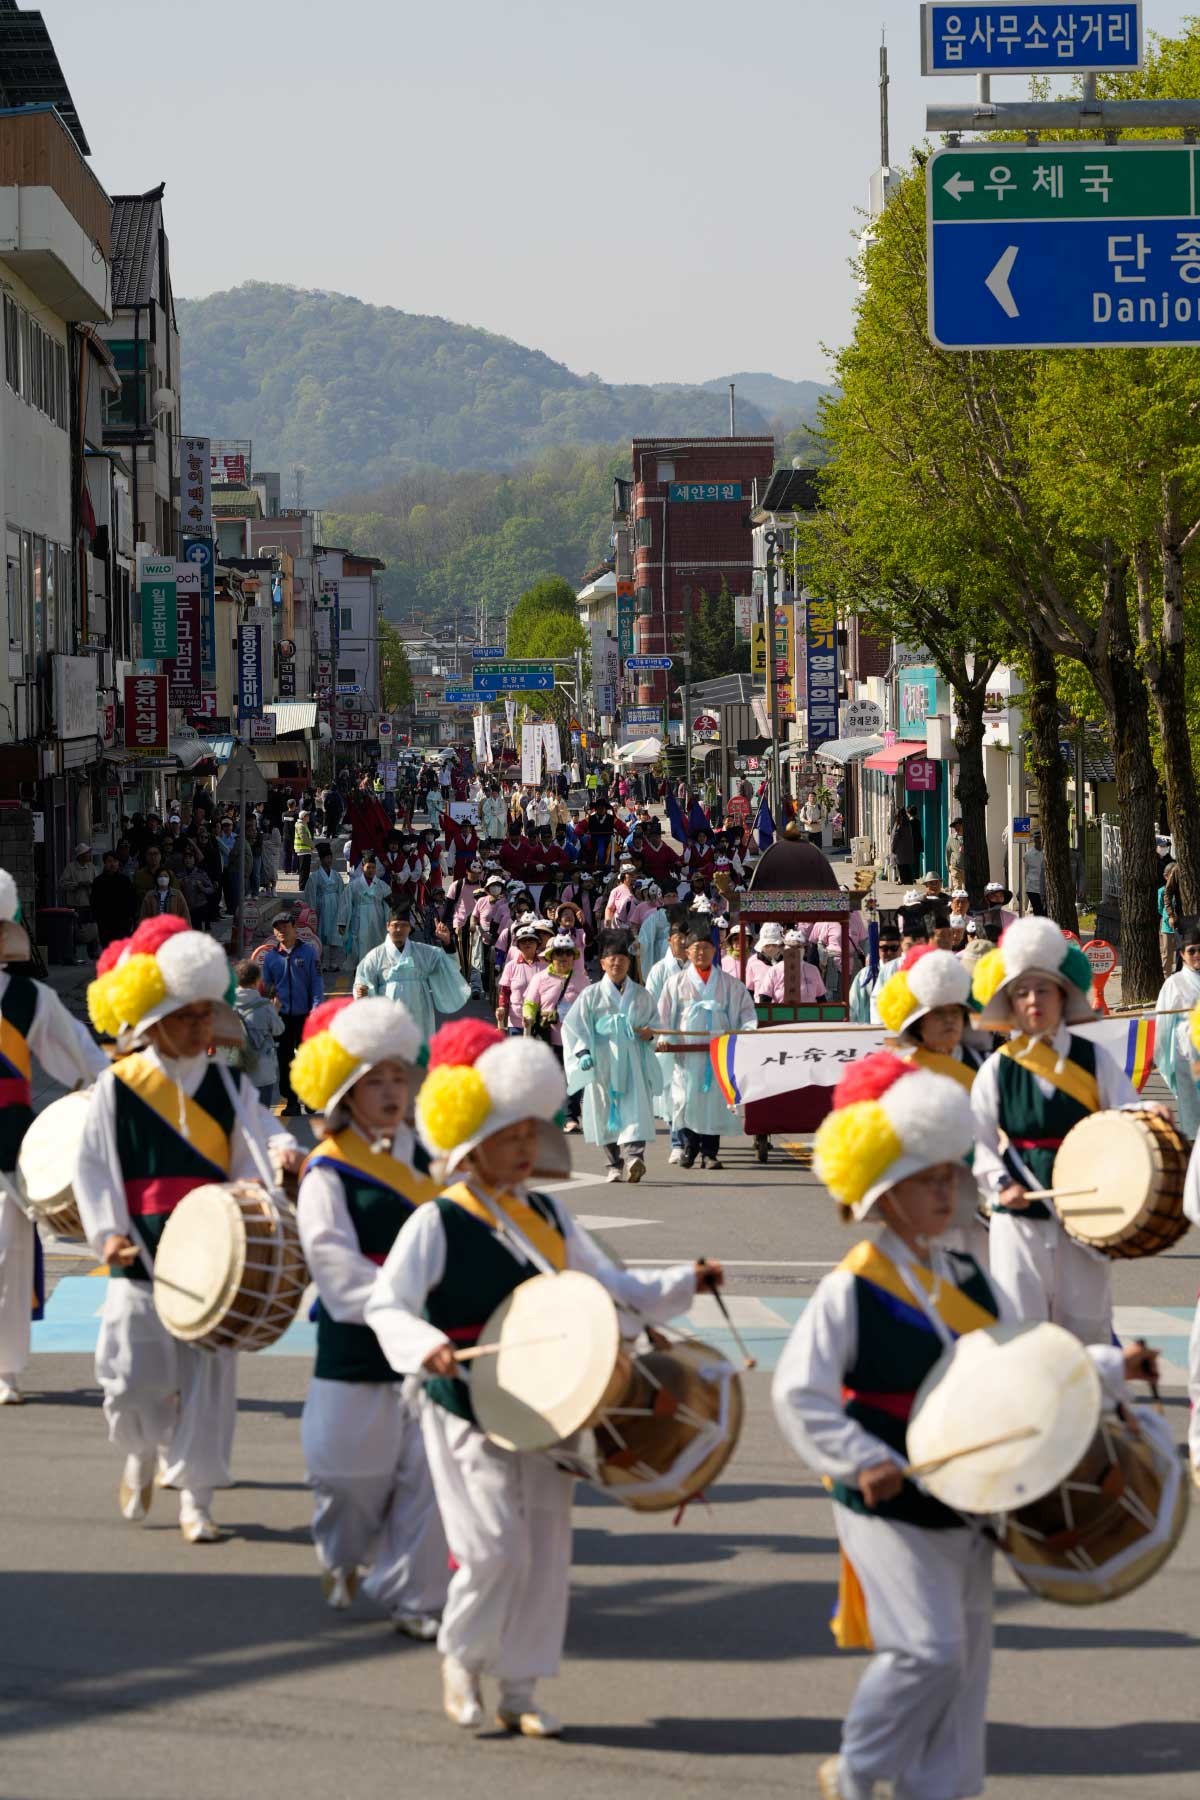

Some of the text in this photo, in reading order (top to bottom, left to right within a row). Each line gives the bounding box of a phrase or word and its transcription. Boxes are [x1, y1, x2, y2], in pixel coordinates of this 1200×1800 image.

[941, 13, 1130, 61] 읍사무소삼거리
[984, 165, 1113, 203] 우체국
[676, 484, 735, 500] 세안의원
[146, 565, 171, 573] WILO
[242, 626, 258, 708] 중앙오토바이
[810, 655, 836, 736] 영월의료기
[849, 716, 880, 726] 장례문화
[909, 762, 933, 789] 약
[761, 1047, 857, 1066] 사육신
